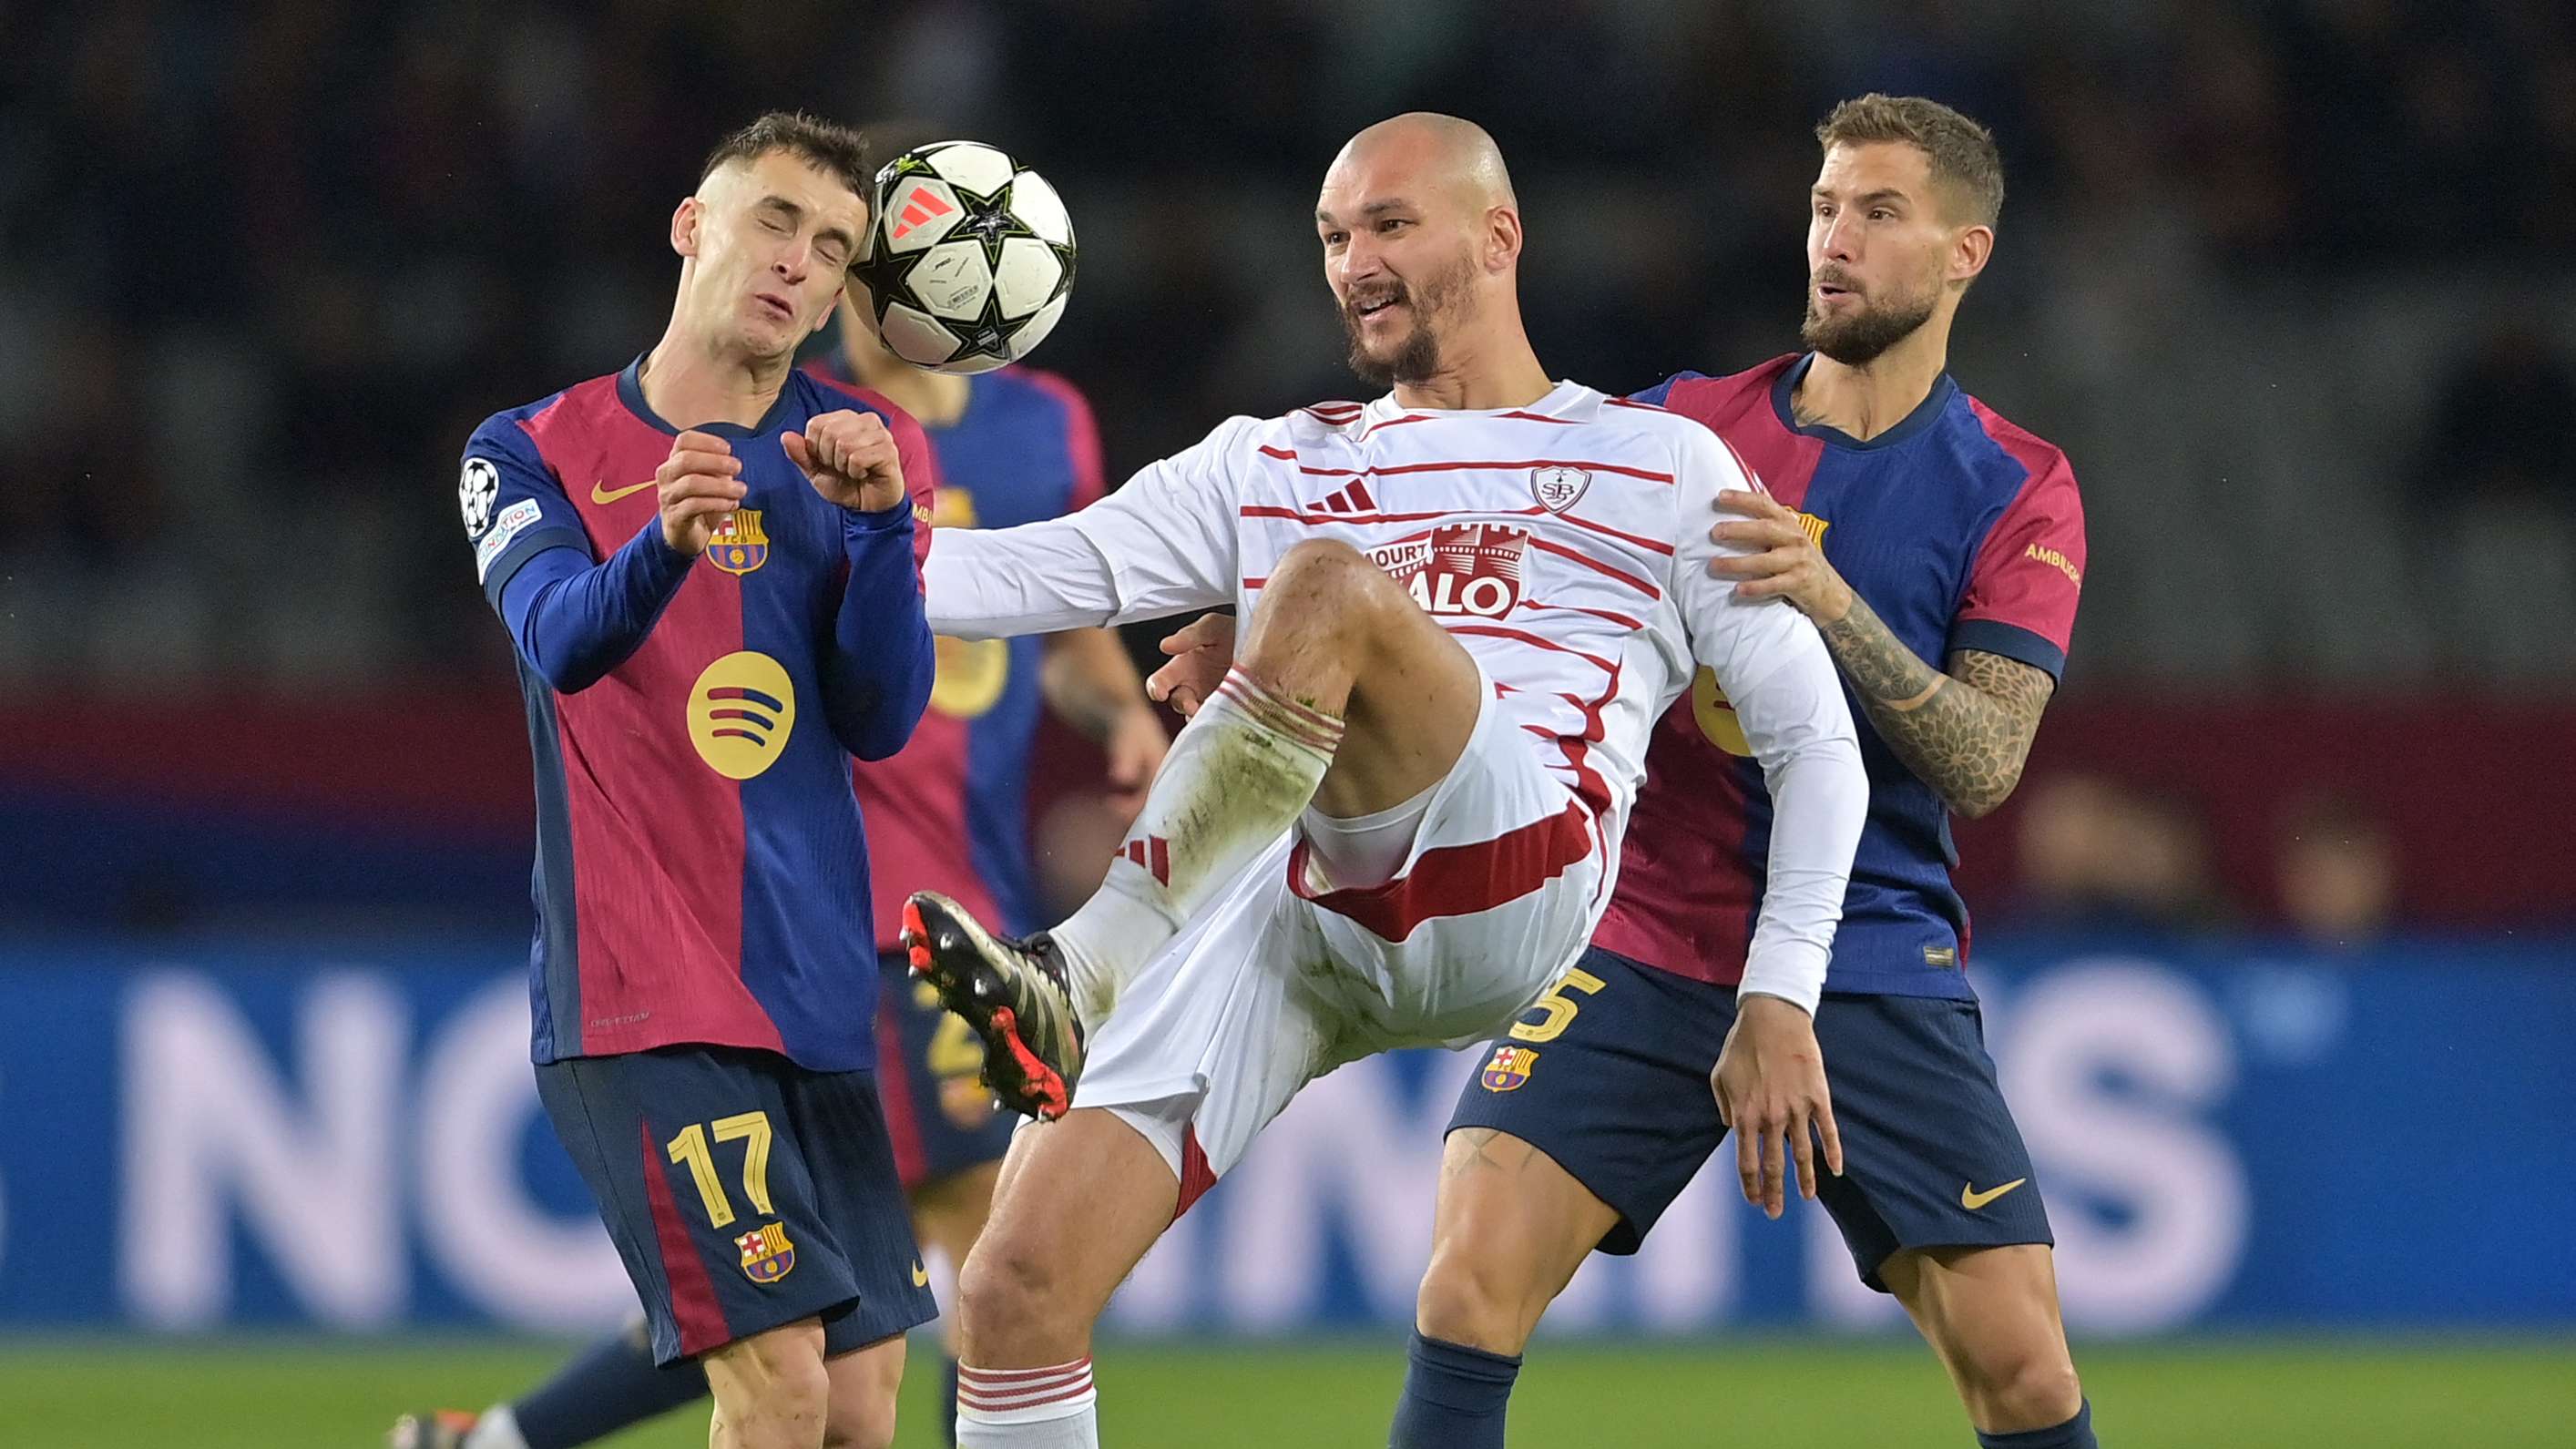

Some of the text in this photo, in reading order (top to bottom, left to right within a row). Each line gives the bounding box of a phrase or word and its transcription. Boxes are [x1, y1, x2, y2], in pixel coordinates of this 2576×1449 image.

[1404, 570, 1511, 617] ALO
[1508, 968, 1607, 1043] 5
[667, 1110, 775, 1230] 17
